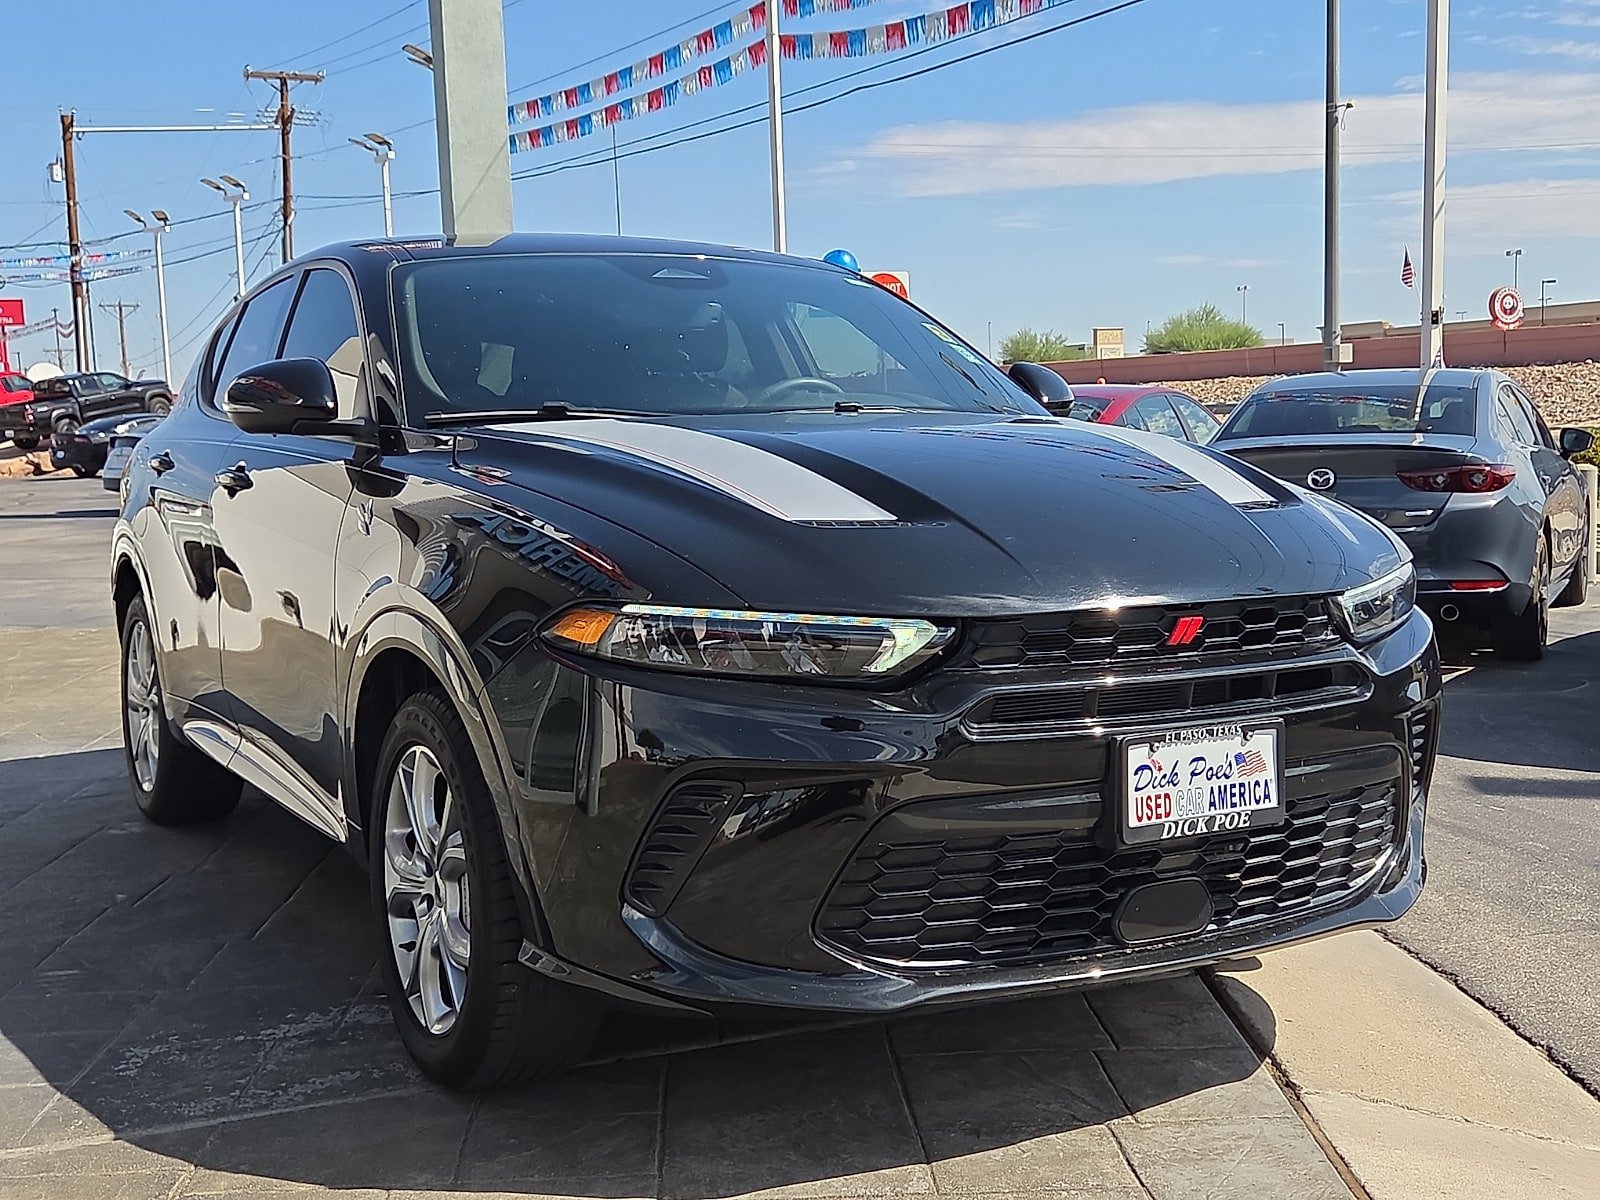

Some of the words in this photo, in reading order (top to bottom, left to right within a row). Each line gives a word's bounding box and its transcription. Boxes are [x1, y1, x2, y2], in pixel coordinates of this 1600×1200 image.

[1166, 731, 1177, 743] EL
[1213, 724, 1242, 738] TEXAS
[1134, 760, 1180, 792] Dick
[1189, 752, 1234, 785] Poe's
[1135, 792, 1172, 823] USED
[1176, 787, 1205, 818] CAR
[1208, 778, 1272, 812] AMERICA
[1160, 815, 1209, 839] DICK
[1212, 811, 1252, 832] POE
